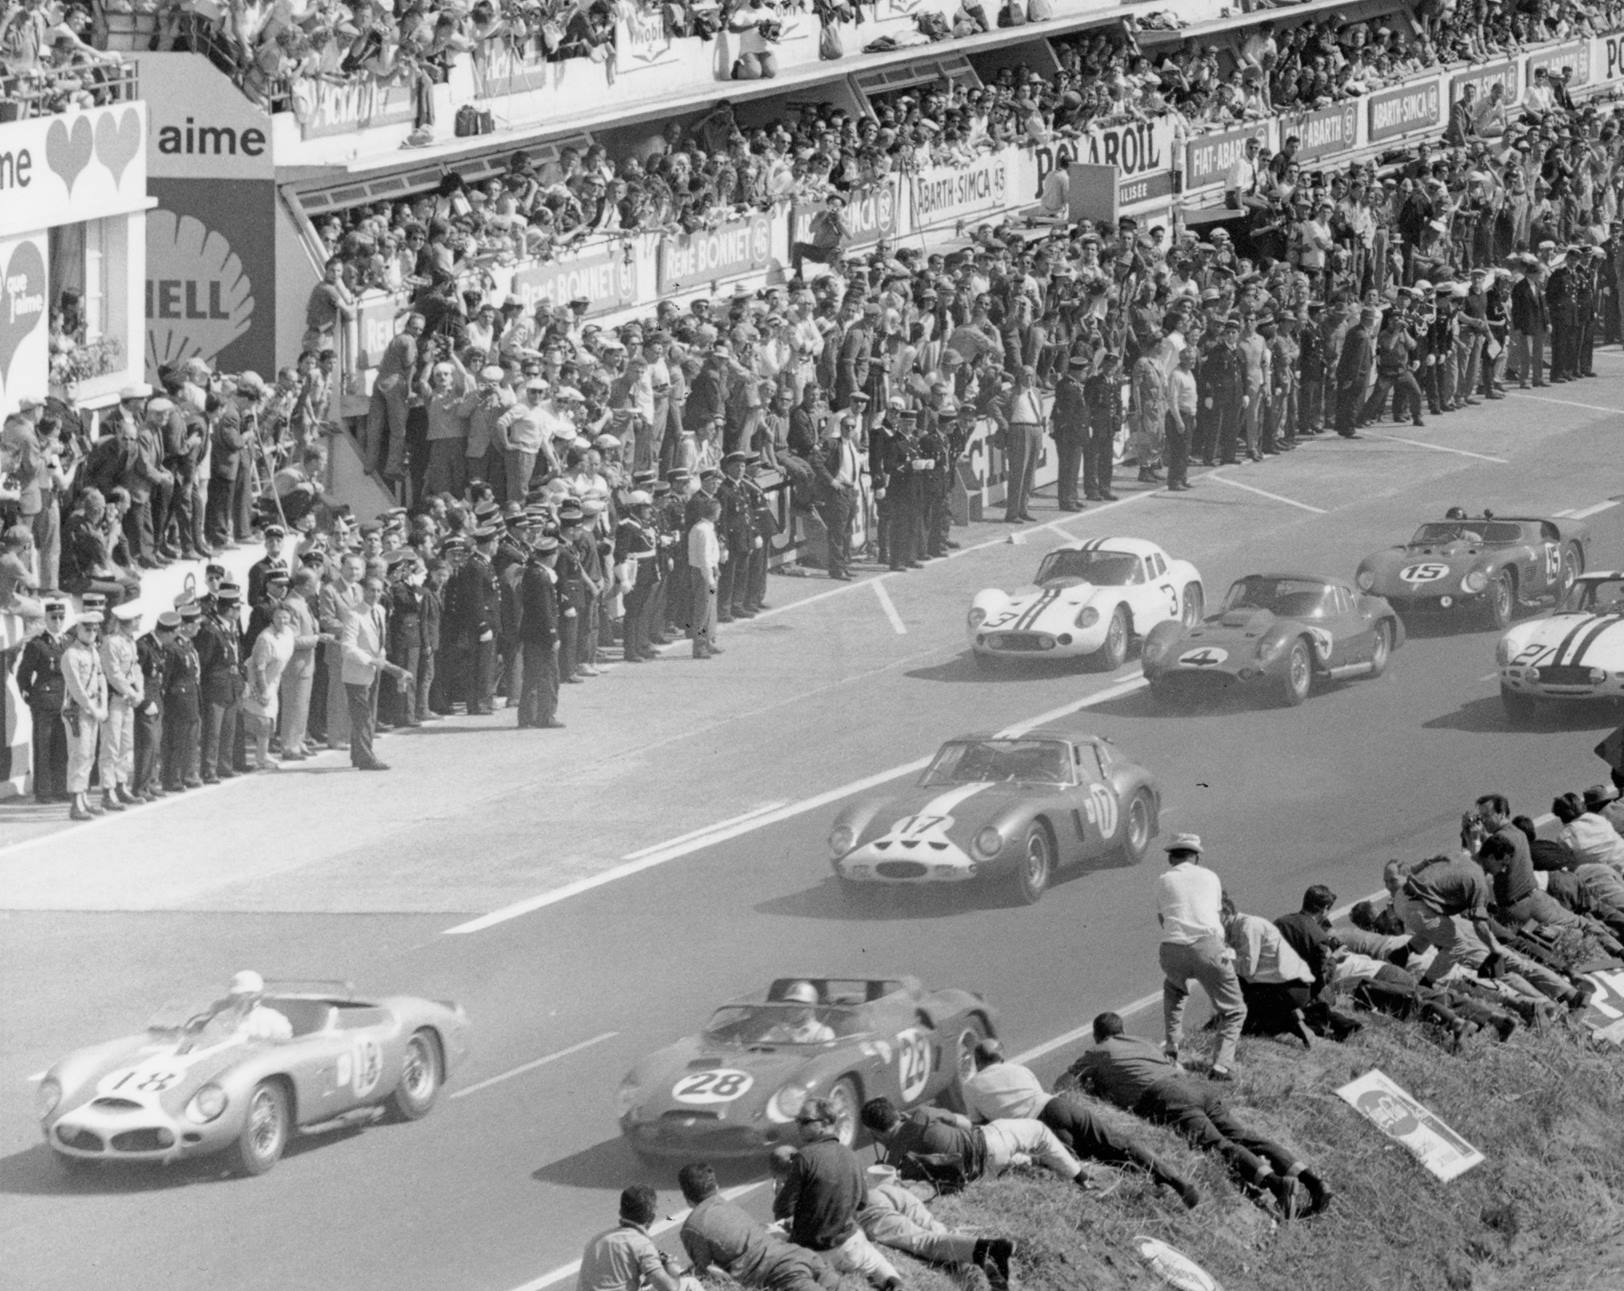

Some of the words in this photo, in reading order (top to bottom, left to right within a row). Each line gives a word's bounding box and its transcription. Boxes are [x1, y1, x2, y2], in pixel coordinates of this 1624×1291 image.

[158, 116, 266, 156] aime
[917, 167, 990, 217] ABARTH-SIMCA
[699, 228, 752, 269] BONNET
[558, 262, 615, 307] BONNET
[146, 279, 230, 320] ELL
[1404, 563, 1446, 582] 15
[1160, 584, 1178, 617] 3
[983, 611, 1019, 627] 3
[1180, 651, 1218, 666] 4
[1509, 643, 1558, 668] 21
[900, 815, 945, 834] 17
[113, 1071, 177, 1092] 18
[676, 1072, 746, 1097] 28
